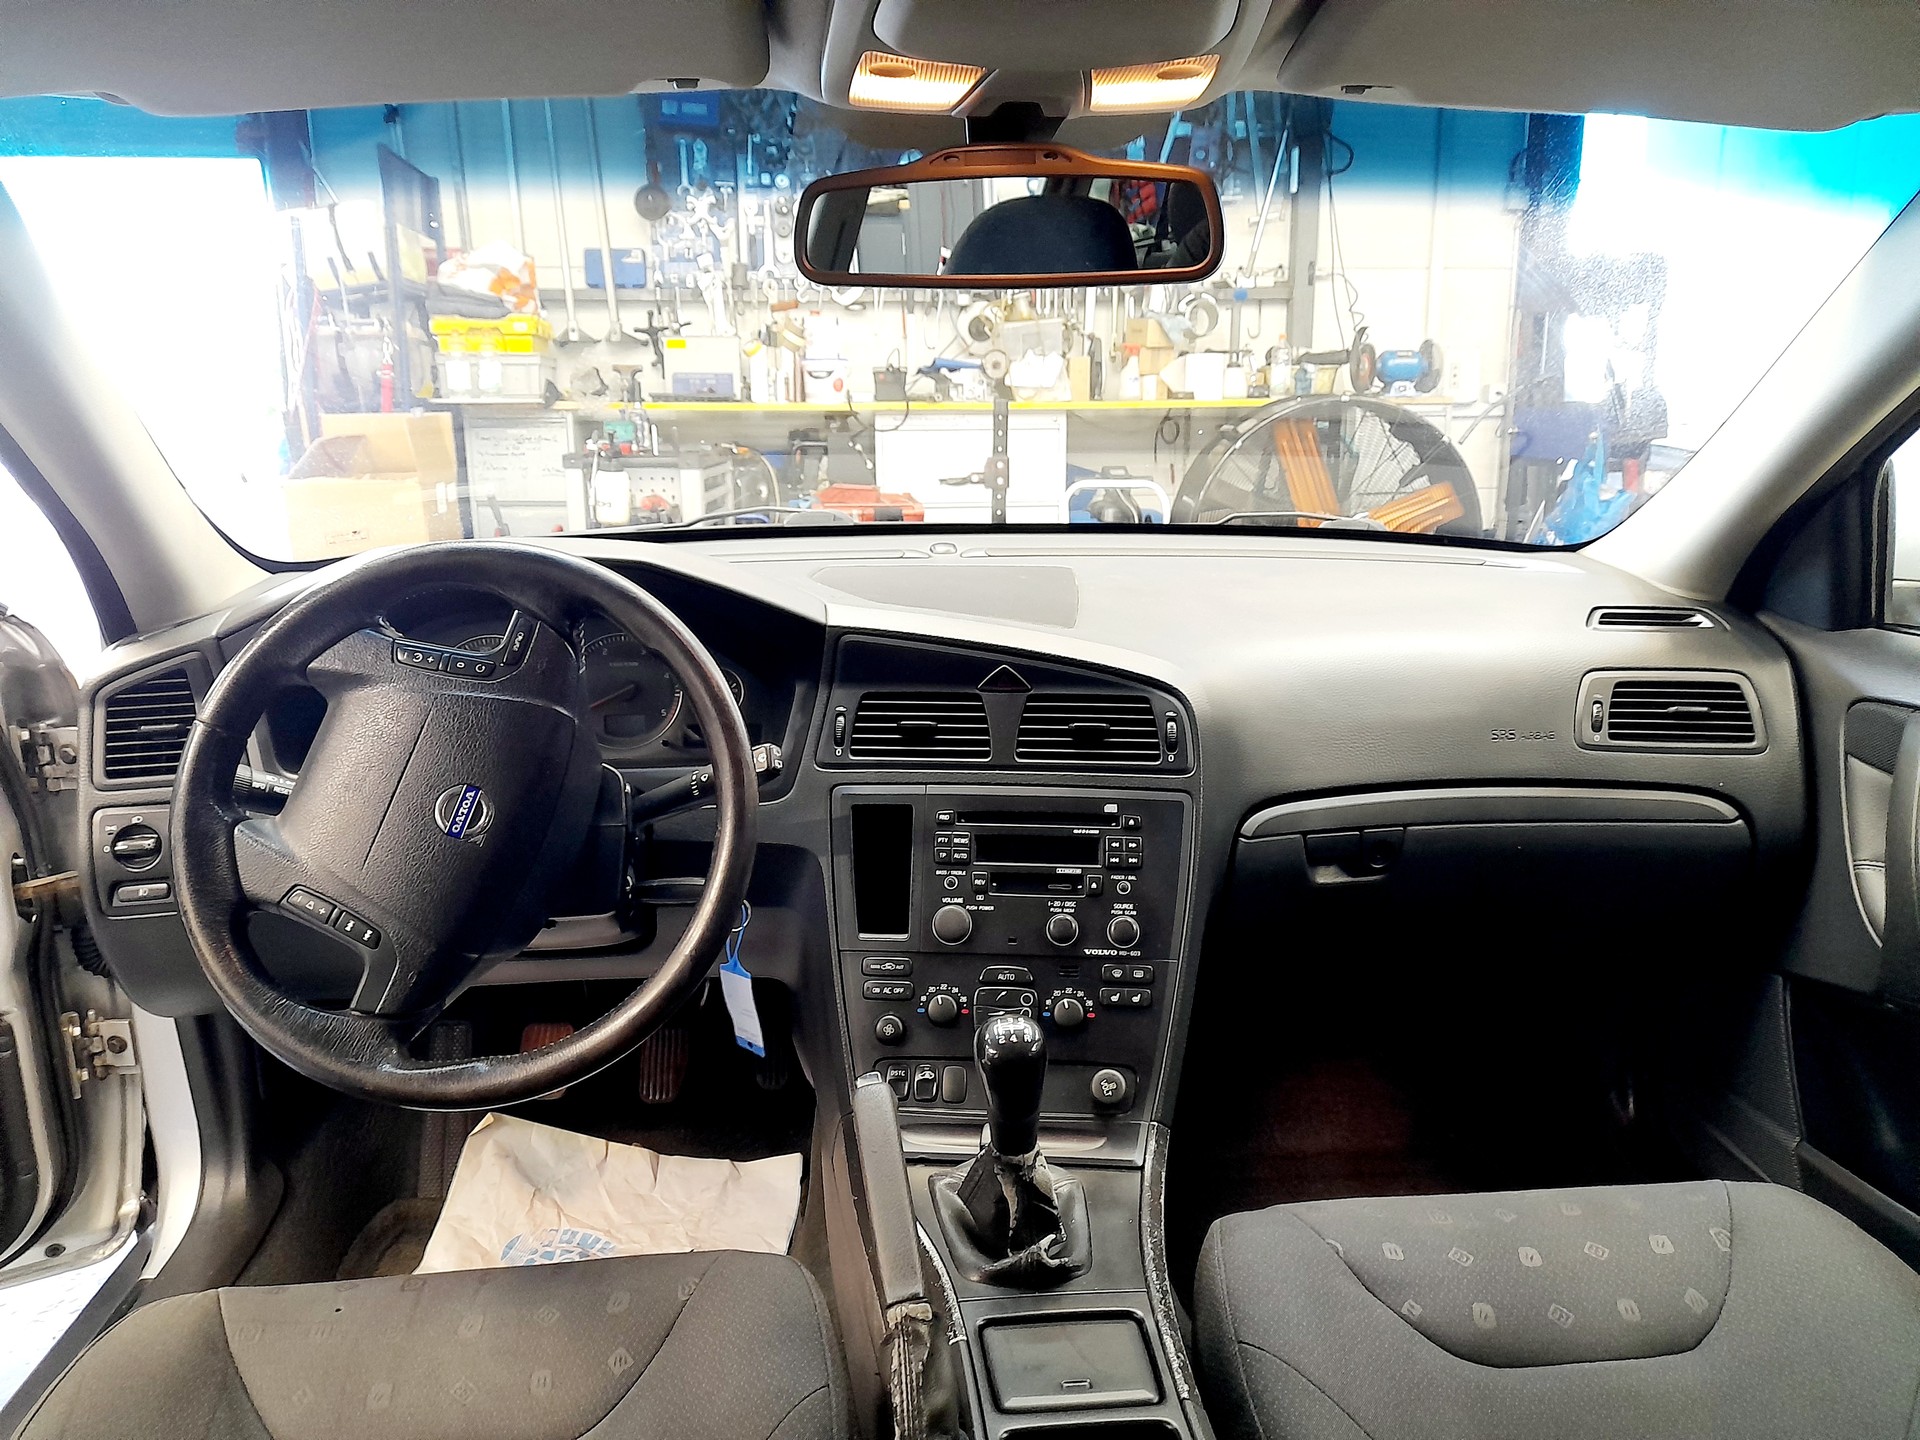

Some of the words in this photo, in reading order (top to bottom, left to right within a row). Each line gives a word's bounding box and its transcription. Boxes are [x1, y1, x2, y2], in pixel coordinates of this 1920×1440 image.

[661, 708, 667, 716] 5
[452, 790, 476, 833] VOLVO
[1083, 948, 1118, 956] VOLVO
[998, 1034, 1006, 1044] 2
[1009, 1033, 1018, 1043] 4
[1023, 1034, 1032, 1043] R
